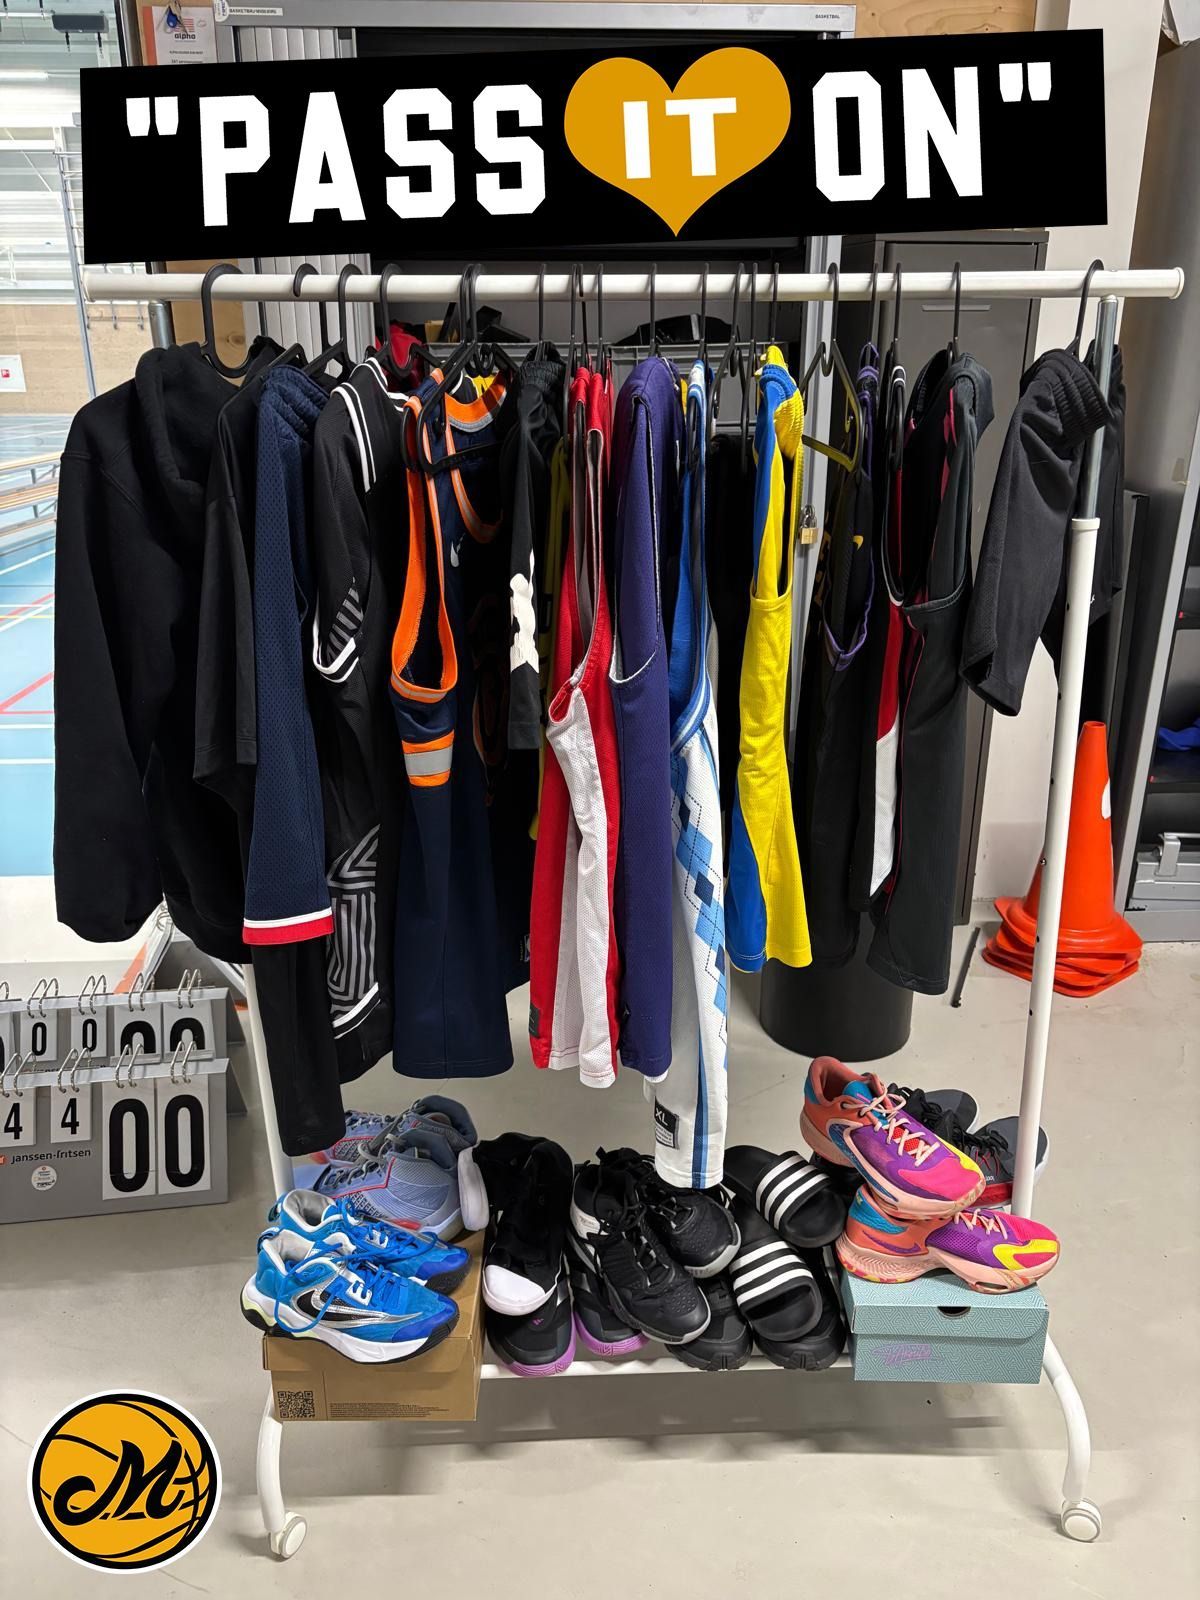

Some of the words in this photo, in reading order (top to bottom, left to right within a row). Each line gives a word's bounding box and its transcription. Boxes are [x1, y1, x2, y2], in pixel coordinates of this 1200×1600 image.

[4, 1102, 23, 1140] 4
[61, 1097, 80, 1135] 4
[655, 1107, 669, 1126] XL
[11, 1149, 91, 1164] janssen-fritsen
